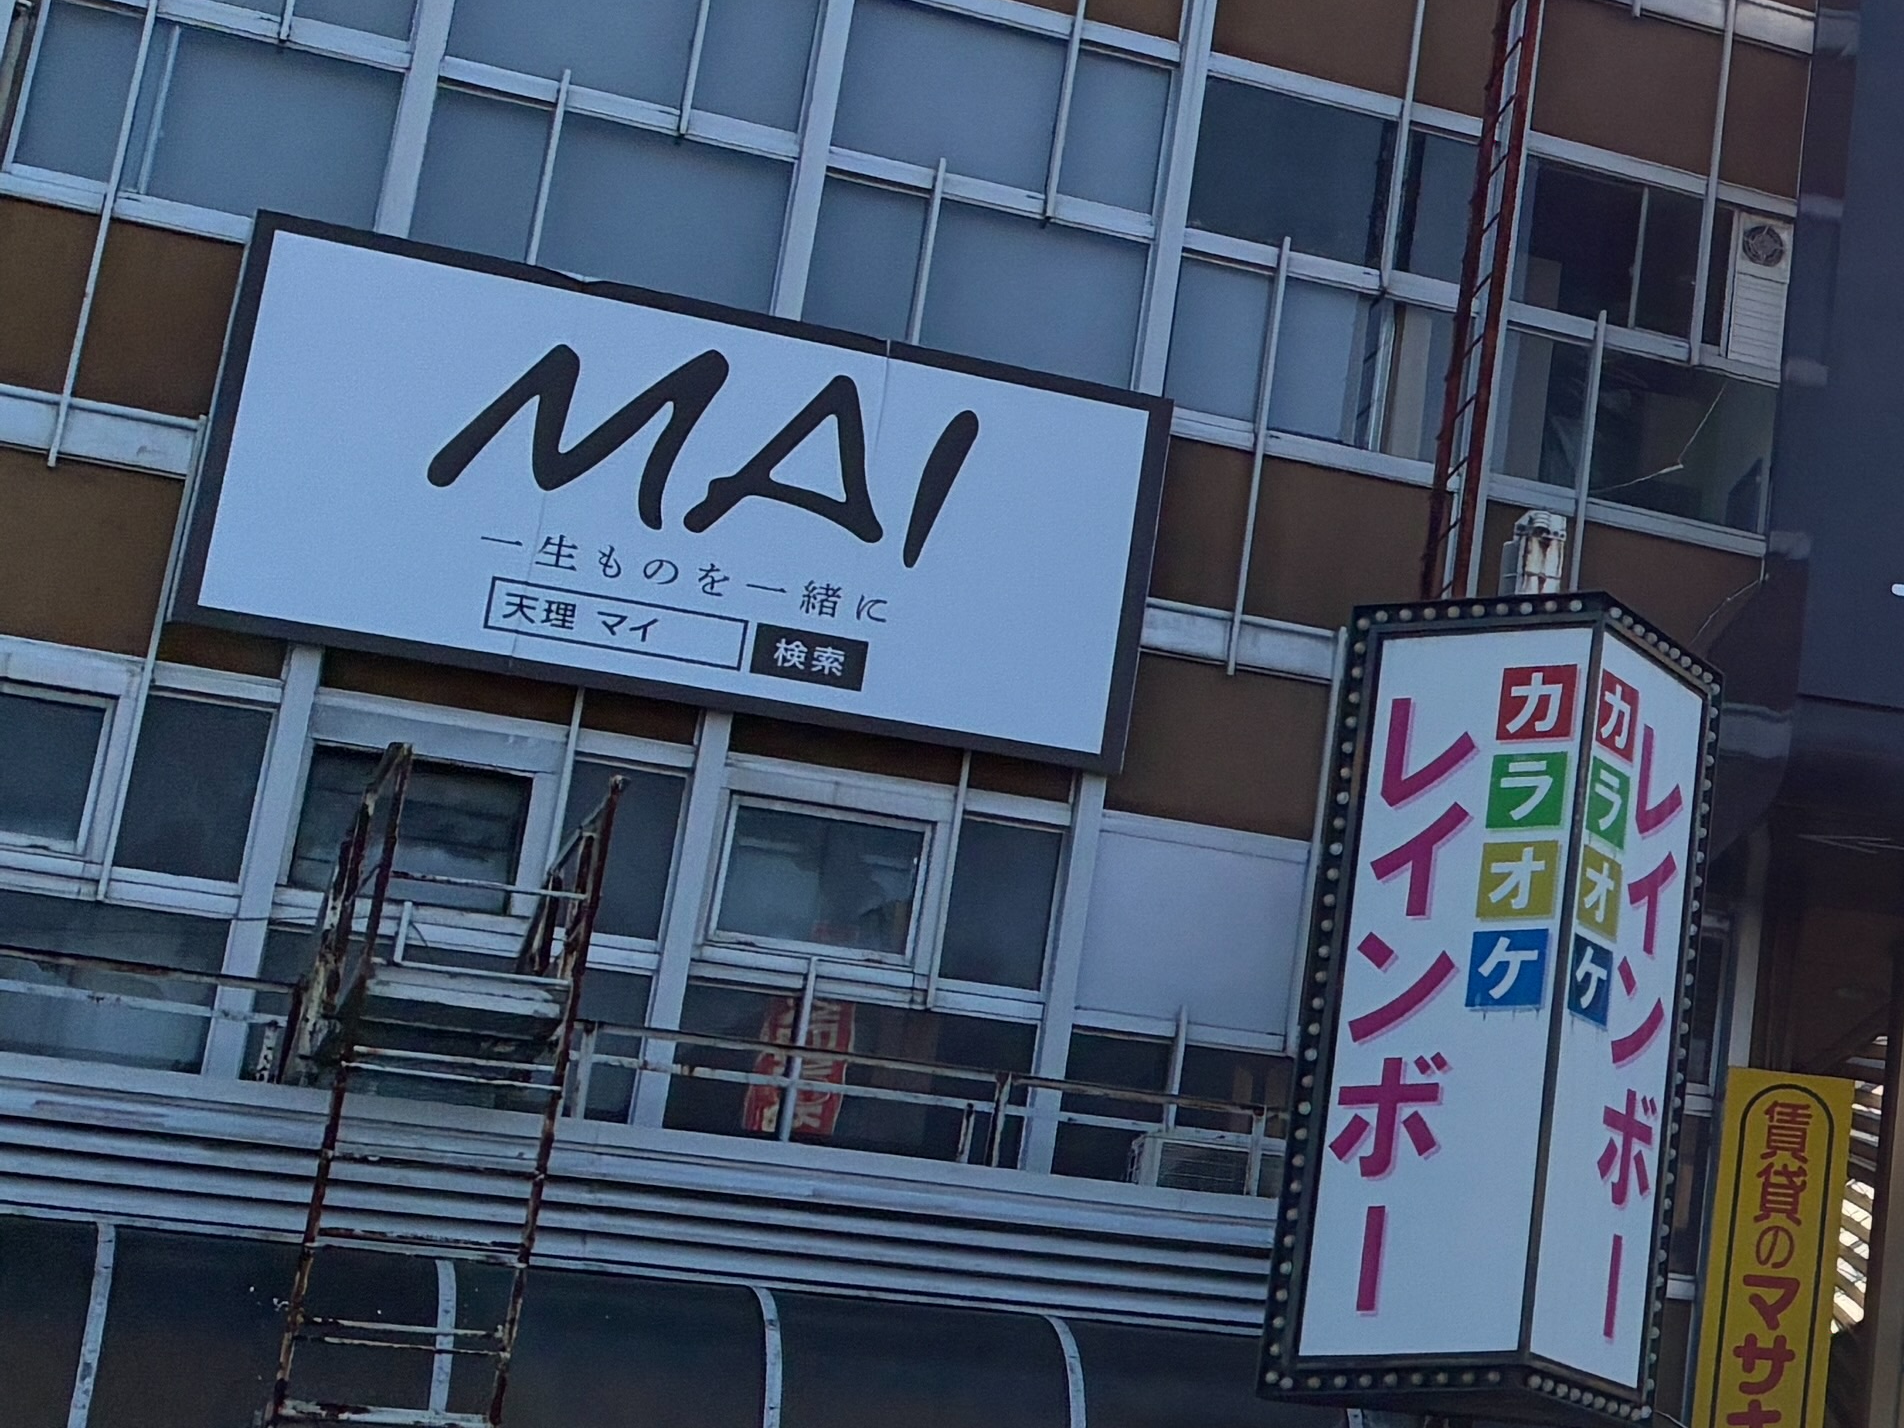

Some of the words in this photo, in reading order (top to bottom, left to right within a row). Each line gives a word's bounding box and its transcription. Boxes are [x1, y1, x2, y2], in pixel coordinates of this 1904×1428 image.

[426, 343, 979, 568] MAI
[480, 533, 888, 625] 一生ものを一緒に
[501, 591, 577, 633] 天理
[597, 610, 660, 644] マイ
[773, 637, 847, 679] 検索
[1477, 671, 1566, 999] カラオケ
[1575, 682, 1632, 1009] カラオケ
[1329, 696, 1478, 1314] レインボー
[1597, 724, 1685, 1339] レインボー
